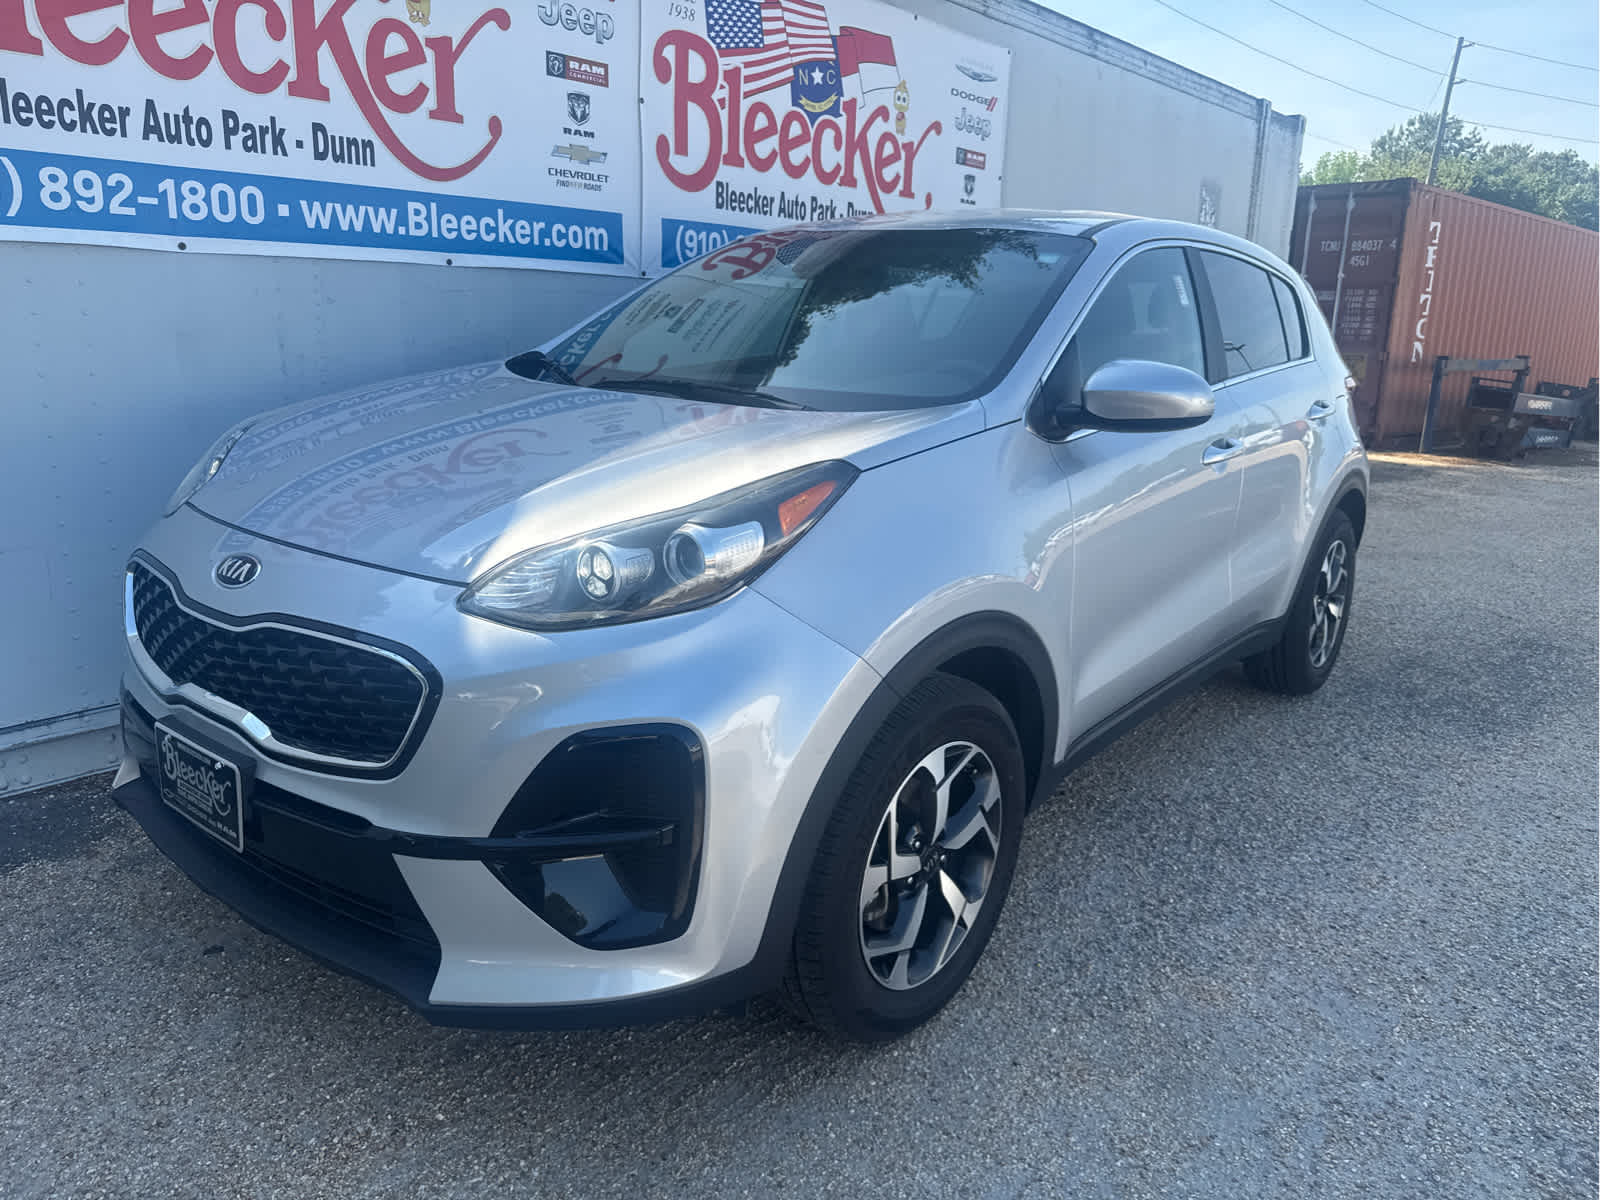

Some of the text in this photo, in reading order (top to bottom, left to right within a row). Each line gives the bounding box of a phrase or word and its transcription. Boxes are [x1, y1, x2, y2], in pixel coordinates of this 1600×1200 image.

[538, 0, 614, 45] Jeep
[668, 2, 696, 21] 1938
[569, 61, 605, 75] RAM
[799, 69, 837, 86] N C
[951, 88, 991, 106] DODGE
[142, 98, 213, 149] Auto
[222, 109, 288, 157] Park
[312, 122, 376, 167] Dunn
[563, 127, 595, 139] RAM
[653, 29, 943, 215] Bleecker
[955, 107, 991, 142] Jeep
[548, 167, 610, 184] CHEVROLET
[38, 166, 265, 226] 892-1800
[300, 200, 609, 252] www.Bleecker.com
[715, 180, 775, 217] Bleecker
[777, 191, 807, 222] Auto
[810, 196, 837, 222] Park
[217, 558, 251, 582] KIA
[161, 733, 232, 817] Bleecker
